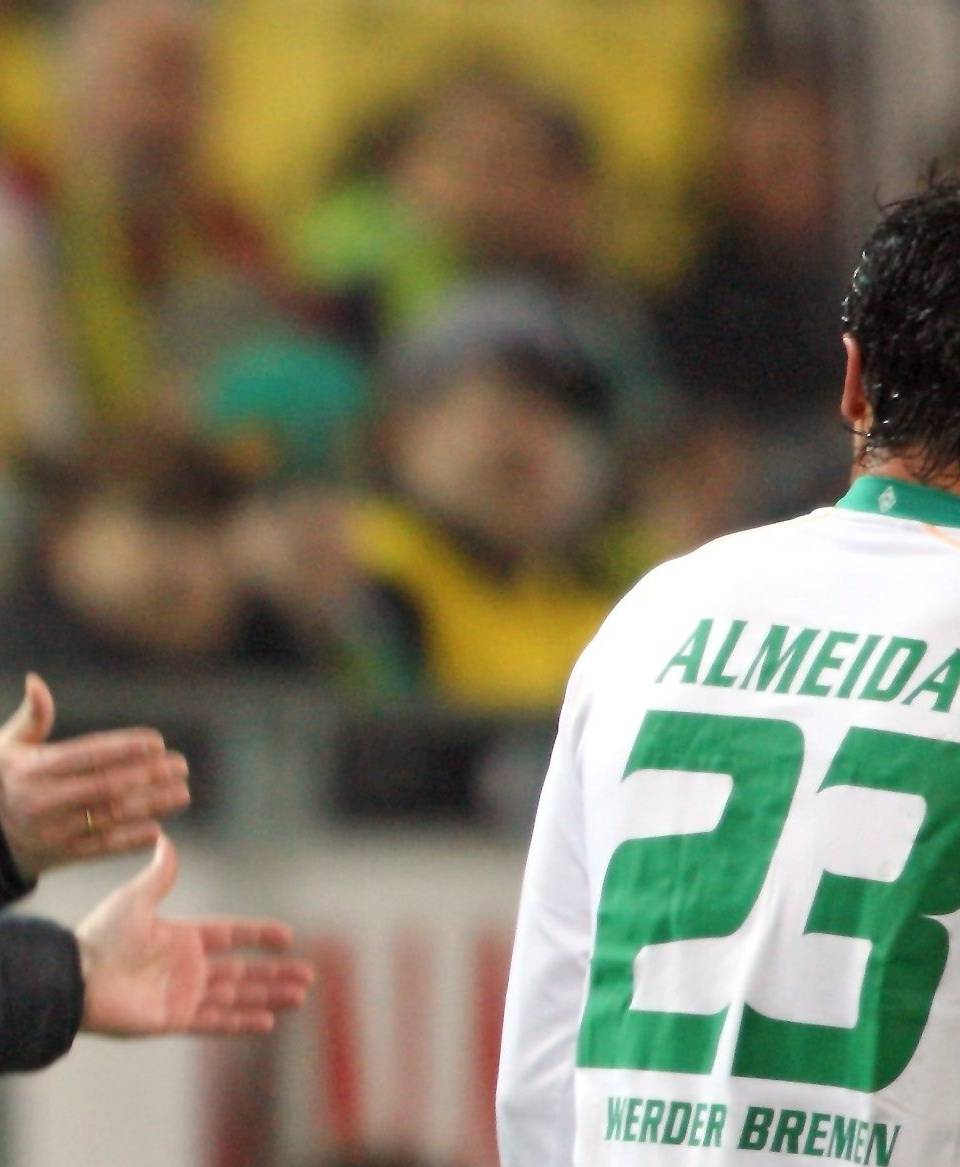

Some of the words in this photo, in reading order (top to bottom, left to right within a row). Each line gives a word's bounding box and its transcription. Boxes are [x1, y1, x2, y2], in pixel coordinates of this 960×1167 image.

[655, 618, 960, 713] ALMEIDA
[577, 709, 960, 1093] 23
[604, 1097, 727, 1147] WERDER
[737, 1106, 902, 1167] BREMEN
